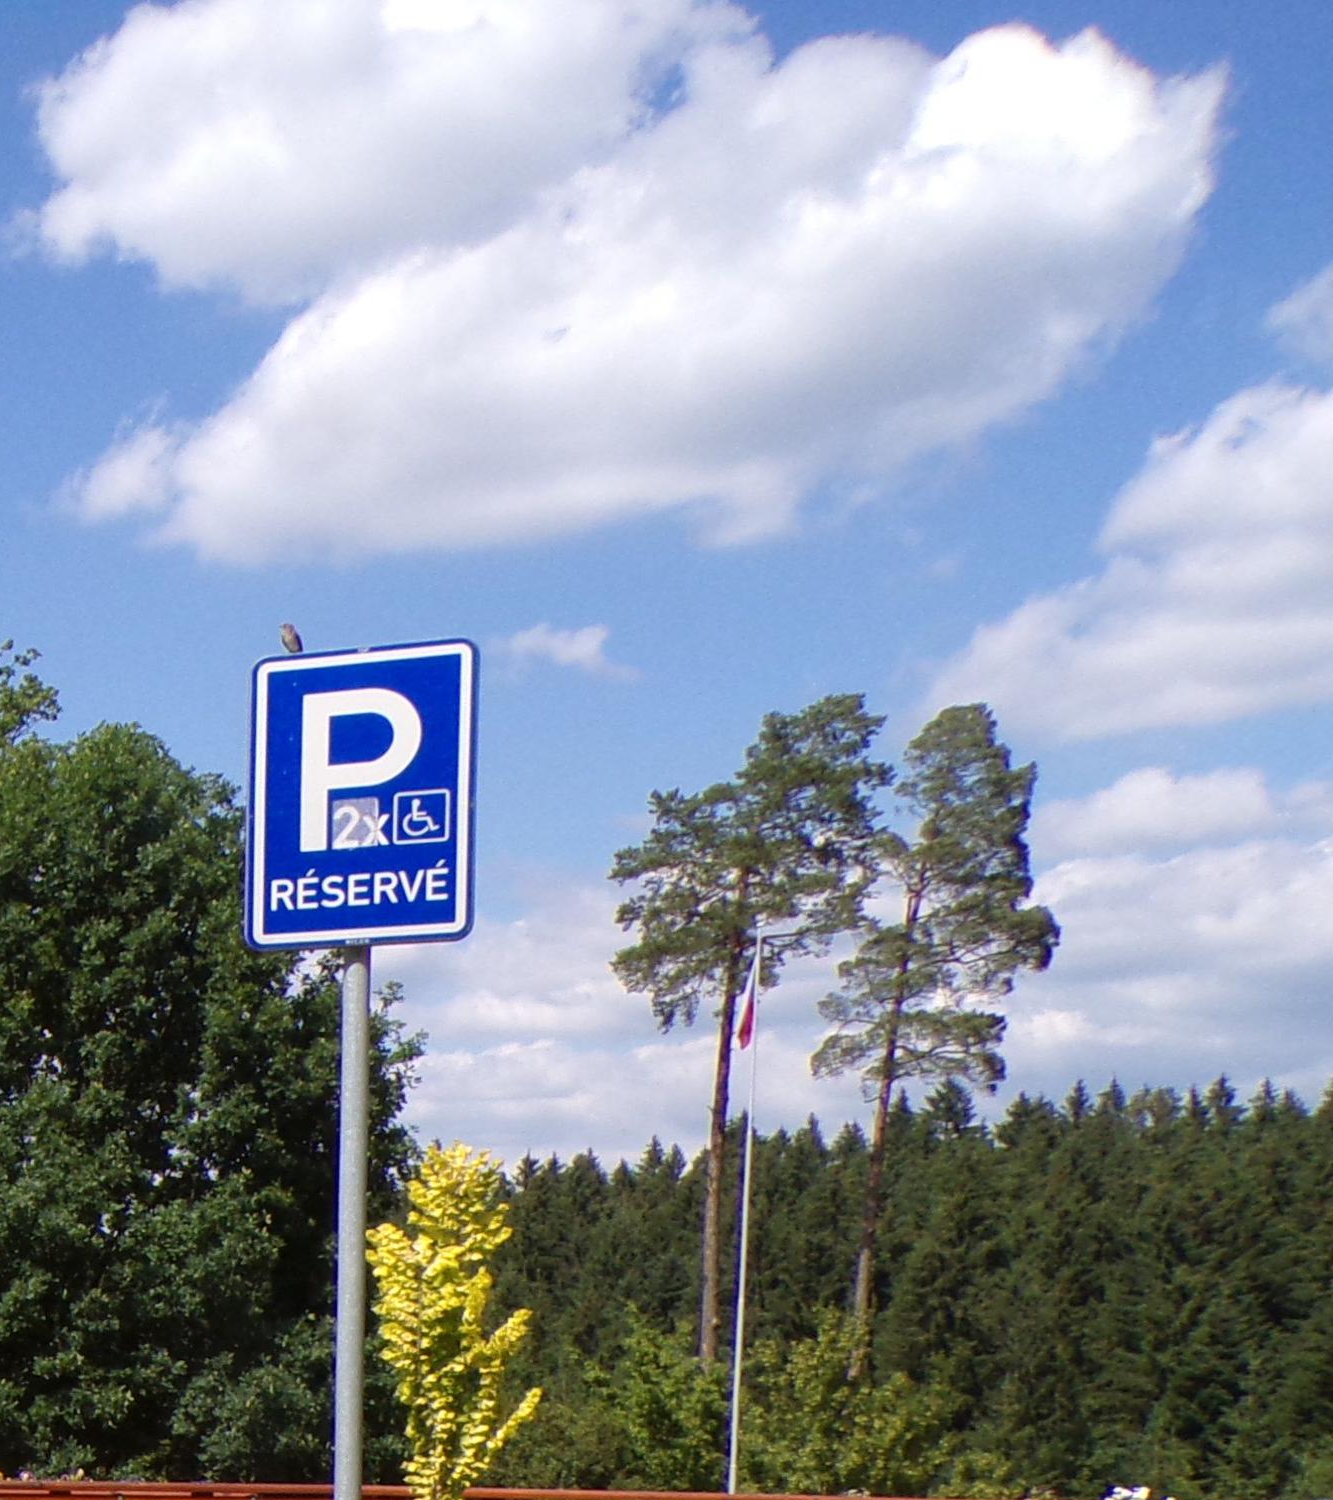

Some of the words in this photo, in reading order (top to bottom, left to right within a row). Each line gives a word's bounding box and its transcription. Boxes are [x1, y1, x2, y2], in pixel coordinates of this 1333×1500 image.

[300, 687, 423, 853] P
[332, 804, 390, 849] 2x
[270, 860, 449, 912] RÉSERVÉ
